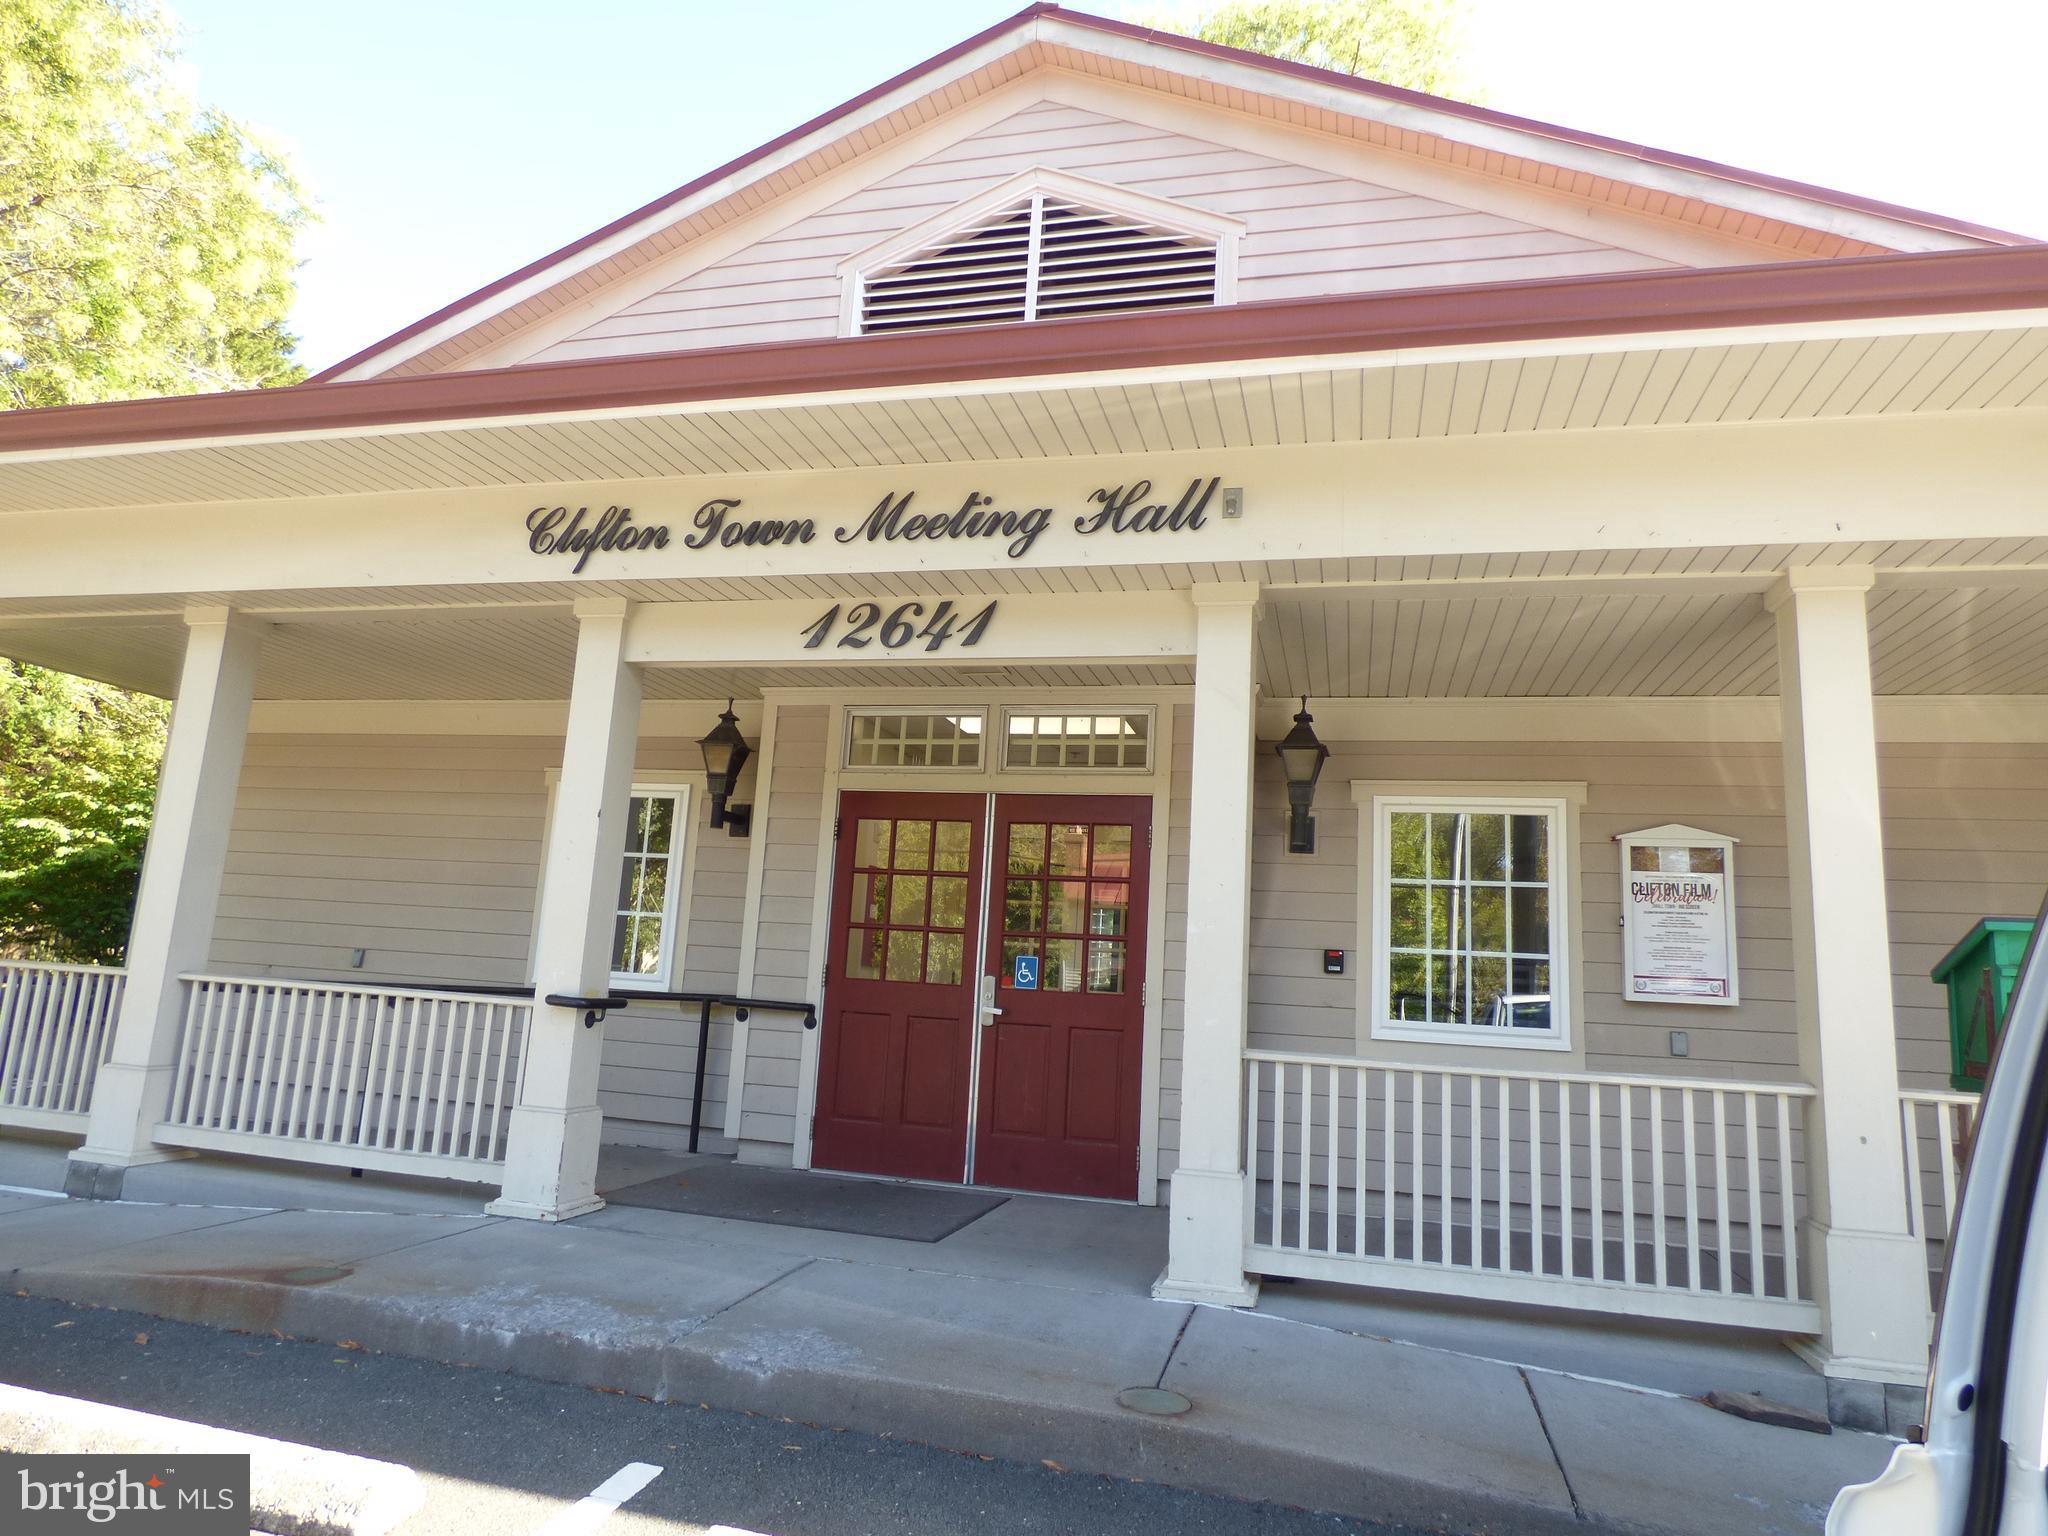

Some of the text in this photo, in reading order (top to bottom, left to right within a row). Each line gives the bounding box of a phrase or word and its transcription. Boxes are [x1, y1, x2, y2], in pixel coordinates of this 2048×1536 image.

[526, 477, 1218, 574] Clifton Town Meeting Hall
[800, 600, 997, 651] 12641
[1631, 882, 1711, 897] CLIFTON FILM
